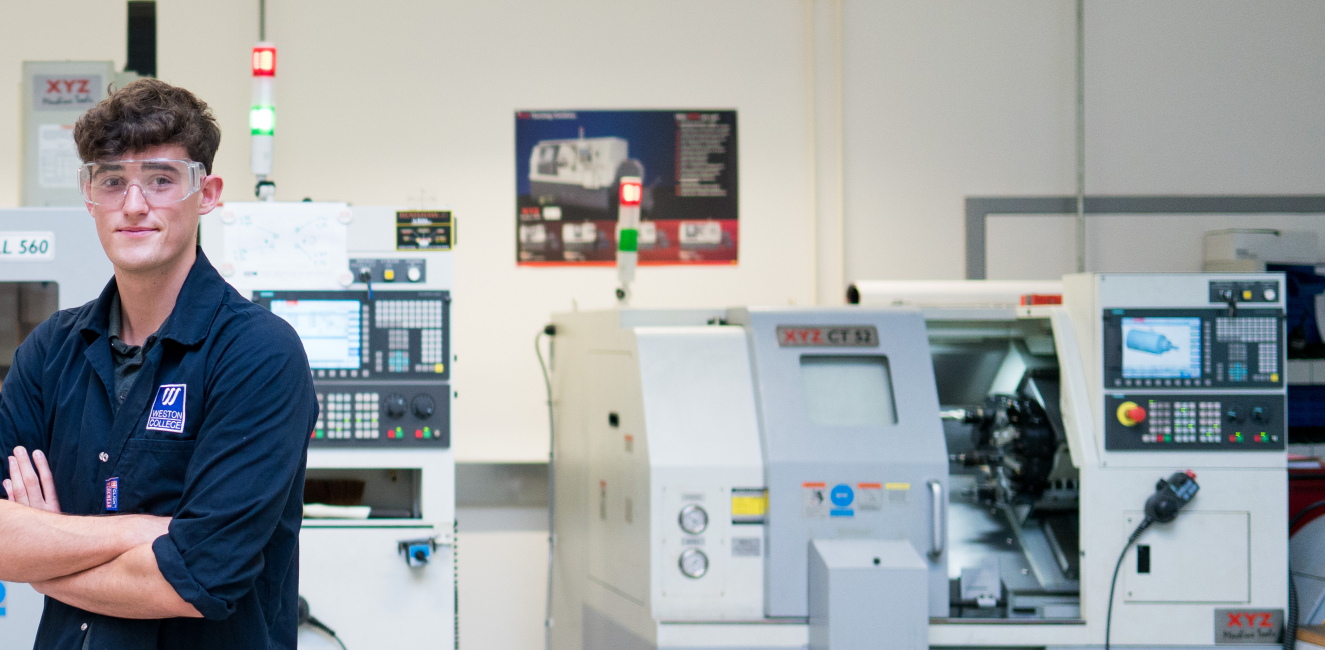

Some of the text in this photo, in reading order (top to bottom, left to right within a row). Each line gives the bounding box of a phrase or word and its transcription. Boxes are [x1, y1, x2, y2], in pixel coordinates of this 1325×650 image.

[45, 79, 91, 94] XYZ
[17, 239, 50, 255] 560
[783, 328, 824, 344] XYZ
[827, 329, 848, 343] CT
[151, 409, 183, 420] WESTON
[148, 418, 182, 430] COLLEGE
[1227, 612, 1273, 628] XYZ
